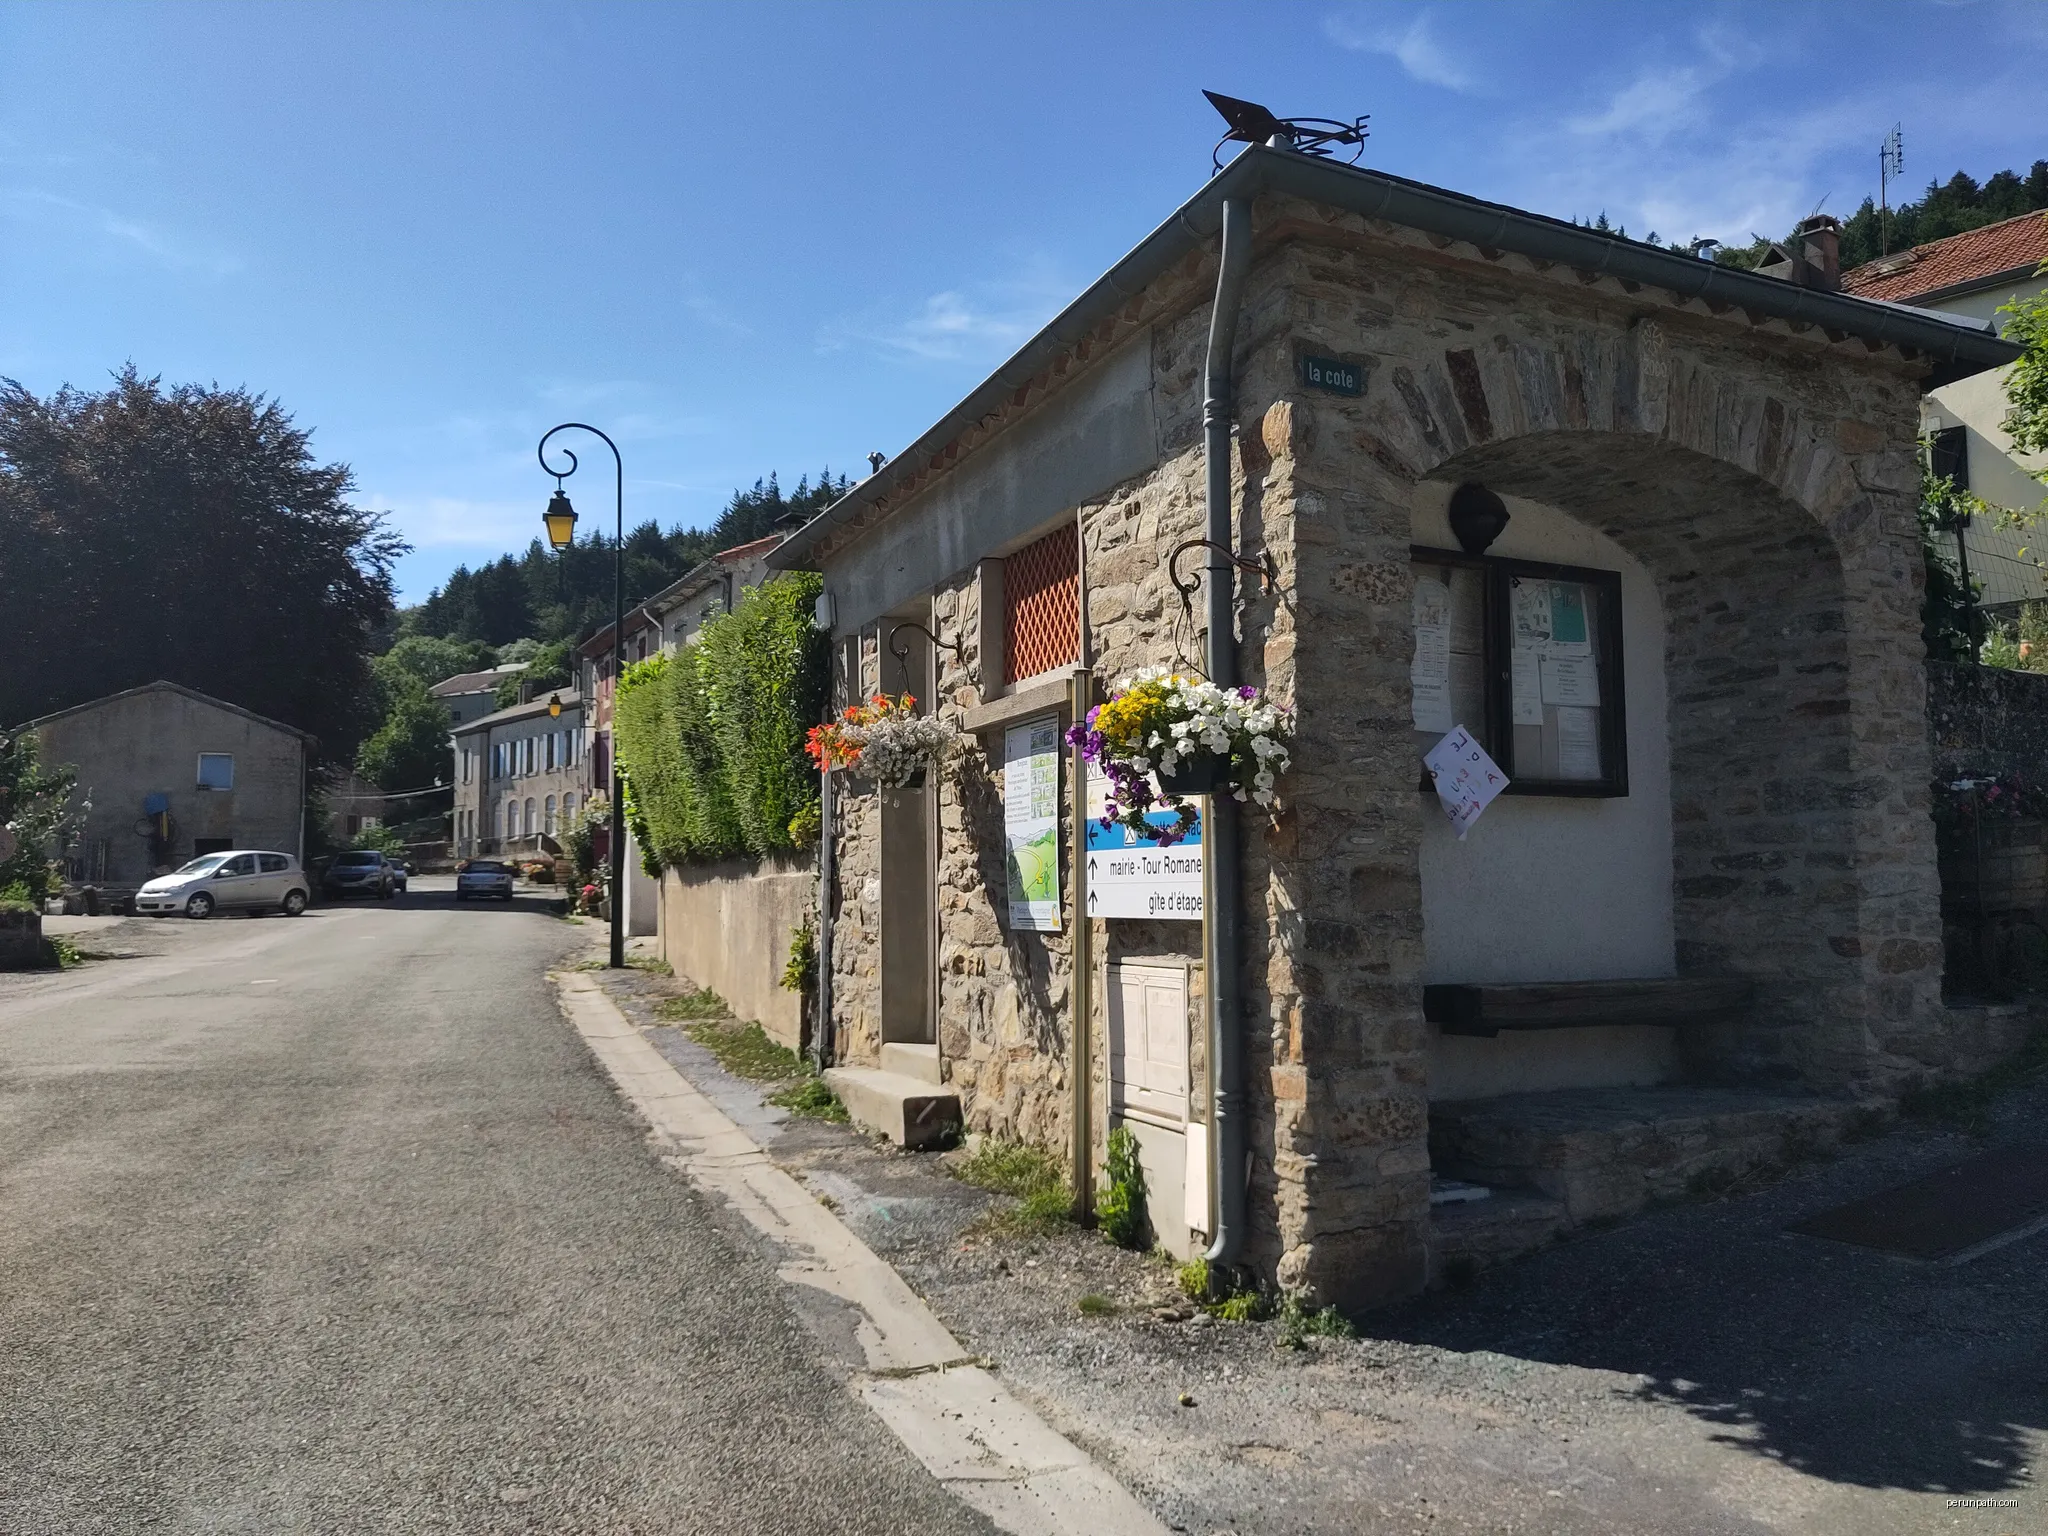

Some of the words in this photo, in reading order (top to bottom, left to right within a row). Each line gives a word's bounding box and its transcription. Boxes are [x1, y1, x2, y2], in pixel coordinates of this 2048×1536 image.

[1308, 362, 1321, 382] la
[1325, 369, 1353, 389] cote
[1109, 857, 1135, 876] mairie
[1141, 856, 1161, 875] Tour
[1163, 855, 1202, 875] Romane
[1148, 891, 1165, 915] gîte
[1167, 890, 1203, 916] d'étape
